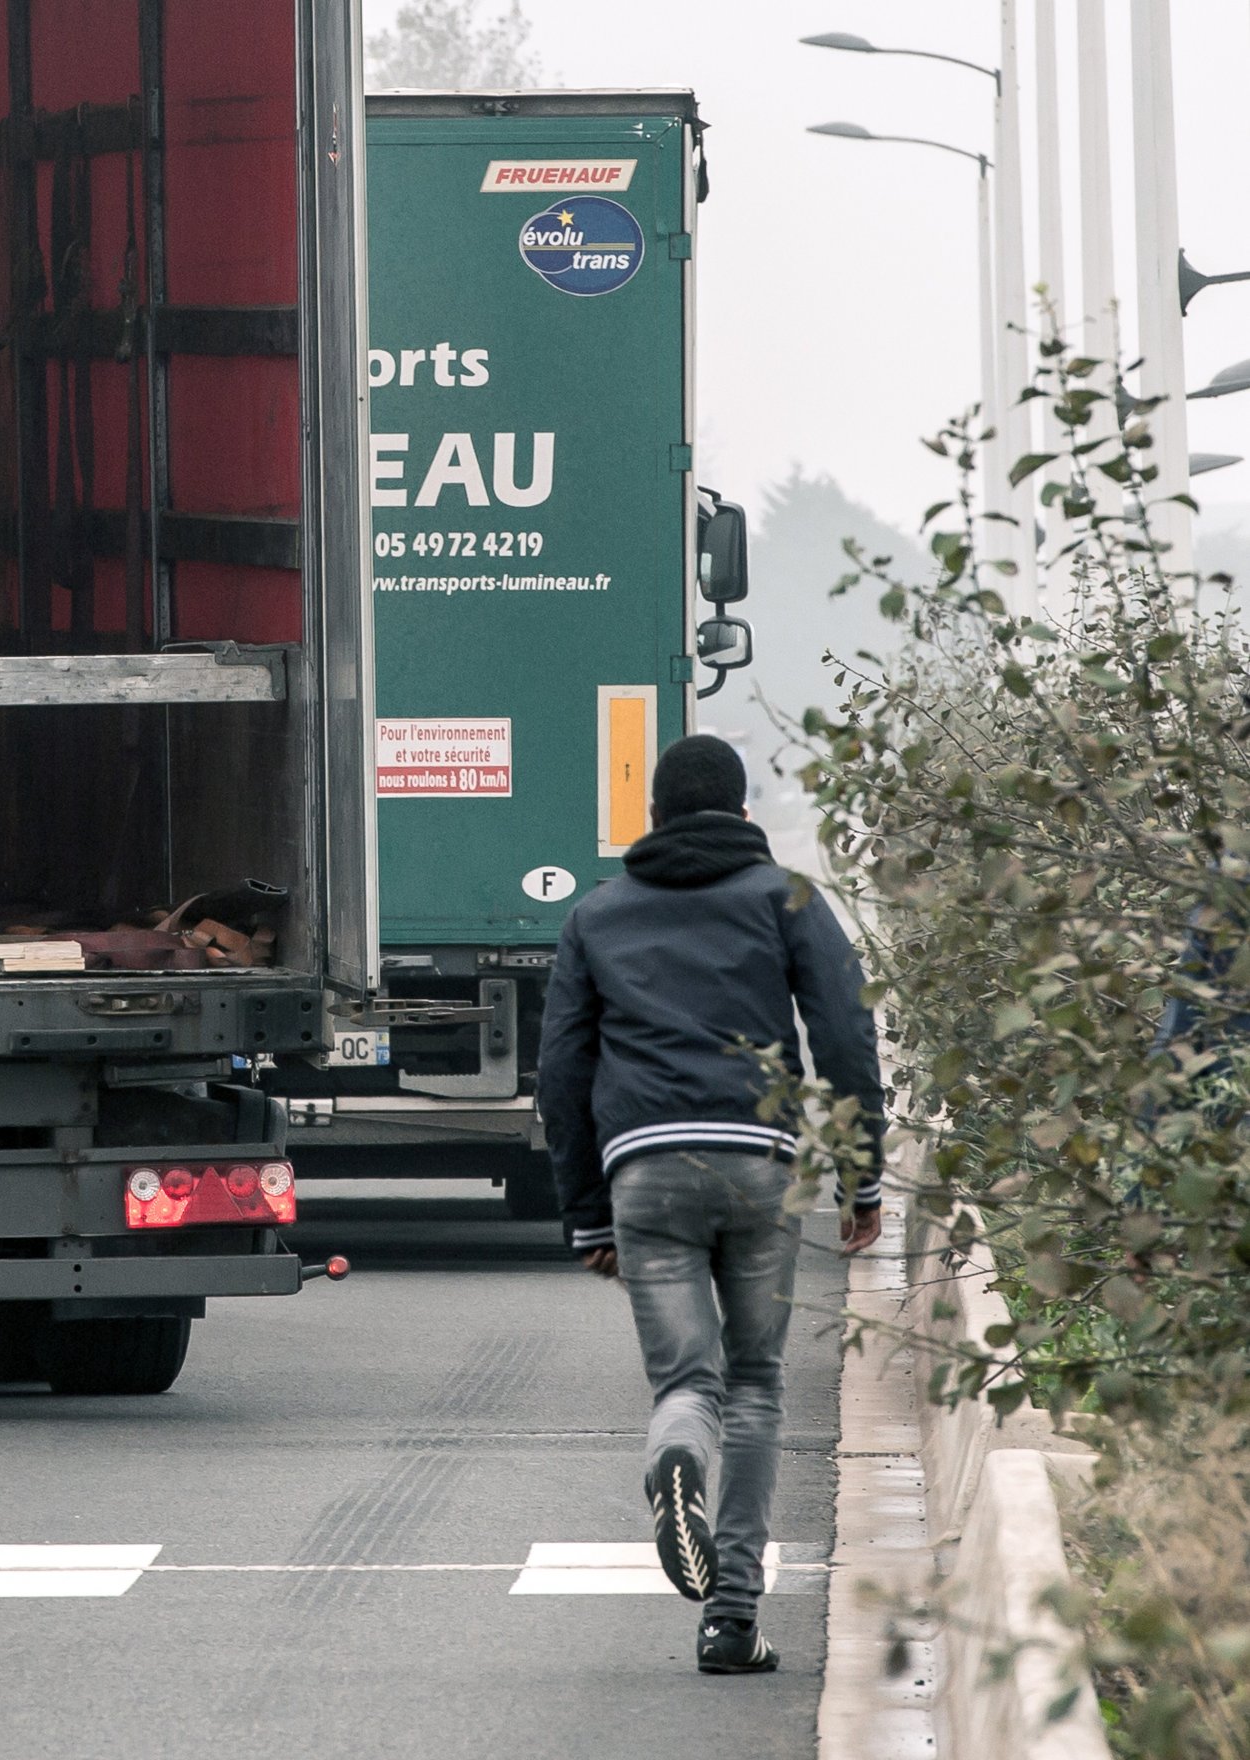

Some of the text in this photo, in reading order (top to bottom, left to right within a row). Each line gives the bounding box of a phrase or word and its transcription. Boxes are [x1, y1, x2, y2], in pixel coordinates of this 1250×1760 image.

[495, 167, 622, 184] FRUEHAUF
[523, 226, 584, 246] évolu
[573, 251, 630, 269] trans
[370, 432, 556, 508] EAU
[375, 532, 406, 557] 05
[412, 532, 444, 557] 49
[448, 532, 477, 556] 72
[380, 724, 506, 741] Pour l'environnement
[395, 745, 491, 762] et votre sécurité
[379, 768, 508, 791] nous roulons à 80 km/h
[542, 871, 556, 897] F
